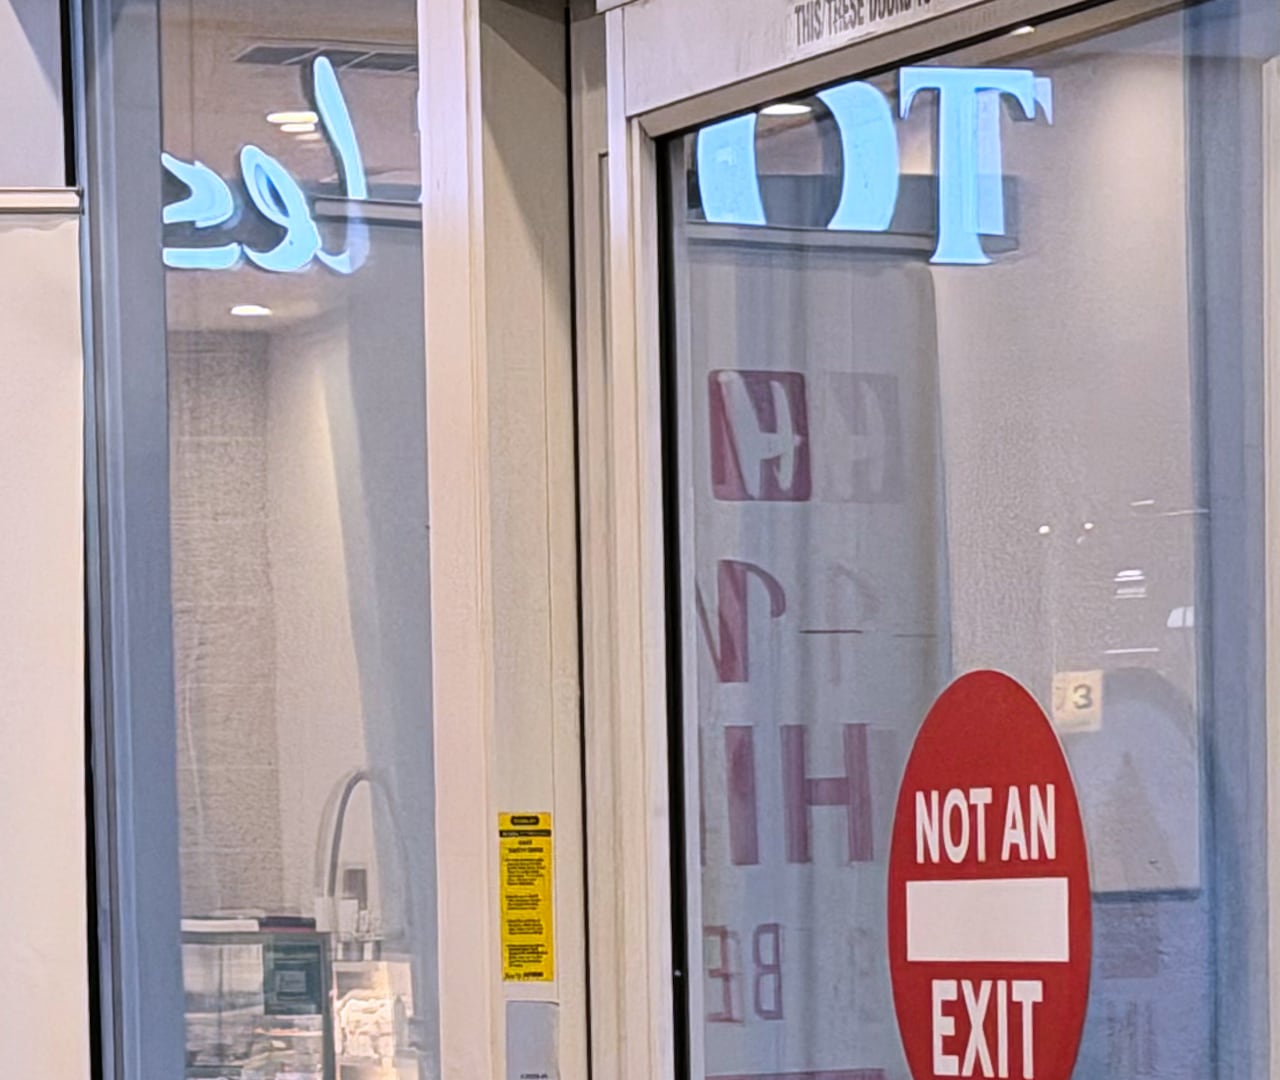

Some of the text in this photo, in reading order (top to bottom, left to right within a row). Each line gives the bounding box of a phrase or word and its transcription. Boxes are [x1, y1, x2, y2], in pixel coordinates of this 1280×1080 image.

[915, 783, 1057, 864] NOT AN
[932, 979, 1043, 1080] EXIT
